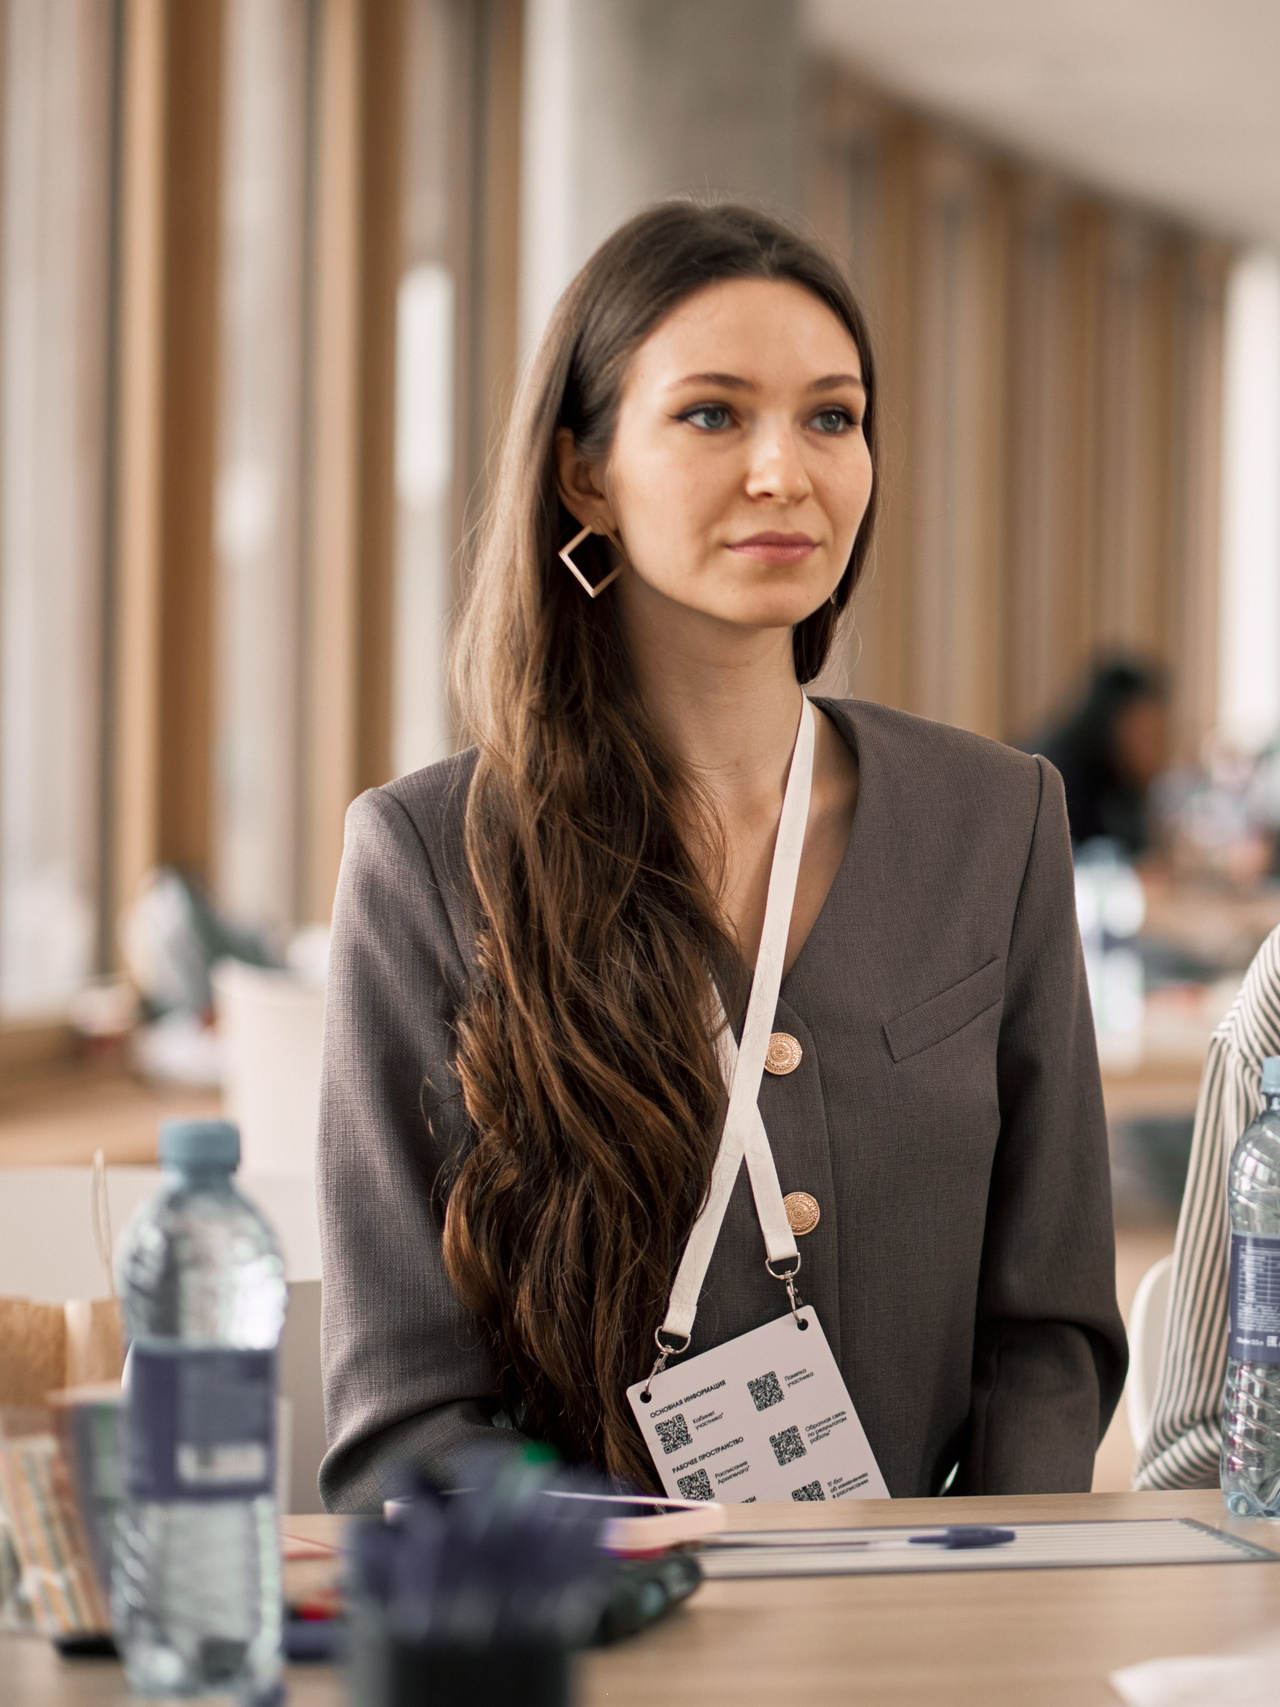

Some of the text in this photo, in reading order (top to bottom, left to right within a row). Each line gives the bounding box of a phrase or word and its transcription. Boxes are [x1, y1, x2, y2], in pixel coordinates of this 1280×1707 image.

[784, 1368, 807, 1381] Памятка
[787, 1371, 815, 1388] участника
[650, 1379, 727, 1418] ОСНОВНАЯ ИНФОРМАЦИЯ
[692, 1410, 716, 1424] Кабинет
[805, 1417, 832, 1432] Обратная
[815, 1416, 848, 1436] результатам
[671, 1436, 744, 1474] РАБОЧЕЕ ПРОСТРАНСТВО
[714, 1460, 748, 1479] Расписание
